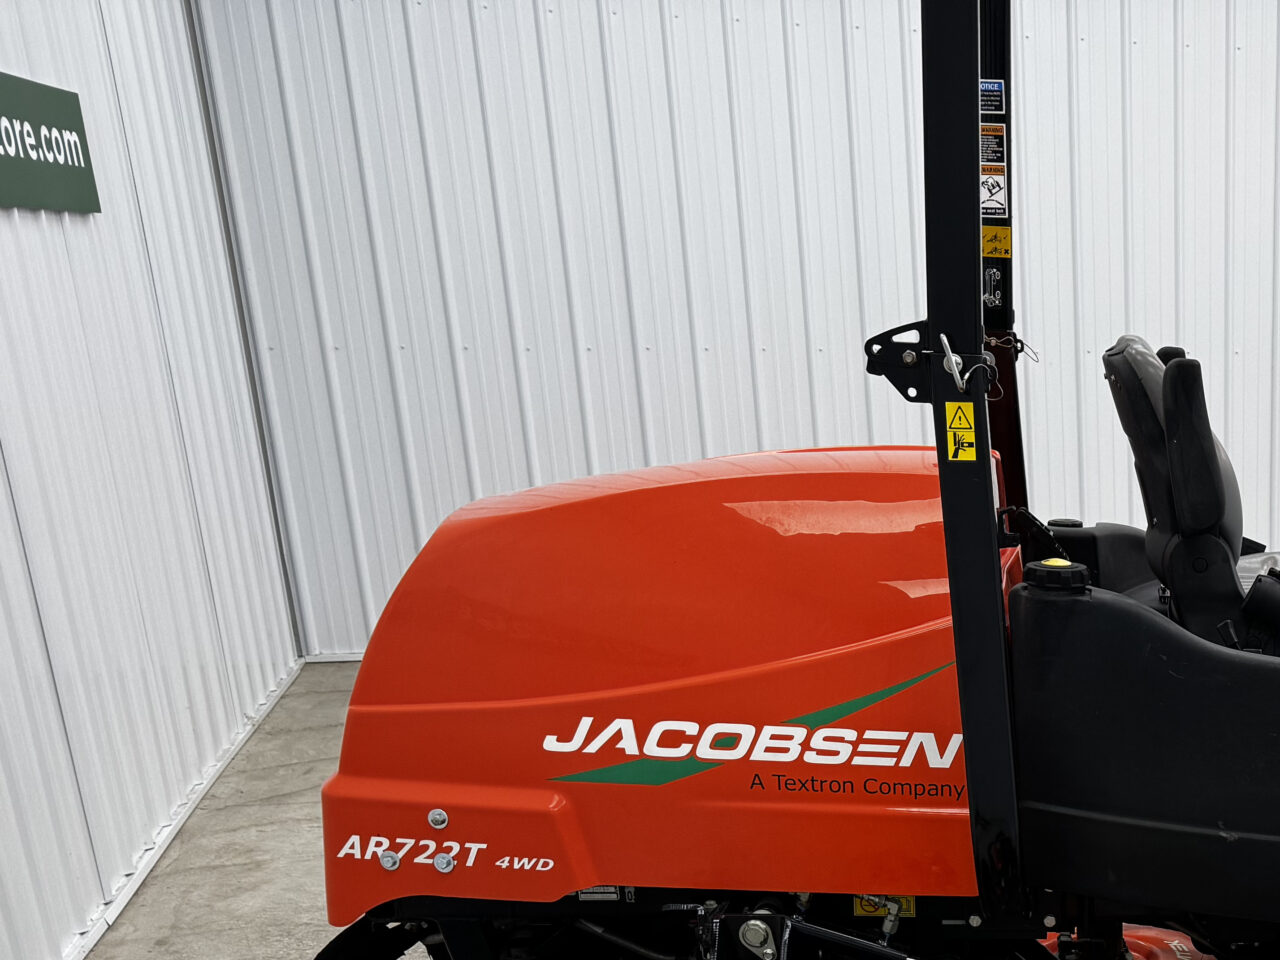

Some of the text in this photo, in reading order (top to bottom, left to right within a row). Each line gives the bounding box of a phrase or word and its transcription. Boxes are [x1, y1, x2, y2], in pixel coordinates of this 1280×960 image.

[543, 717, 964, 769] JACOBSEN
[750, 774, 965, 801] A Textron Company
[337, 835, 555, 871] AR722T 4WD
